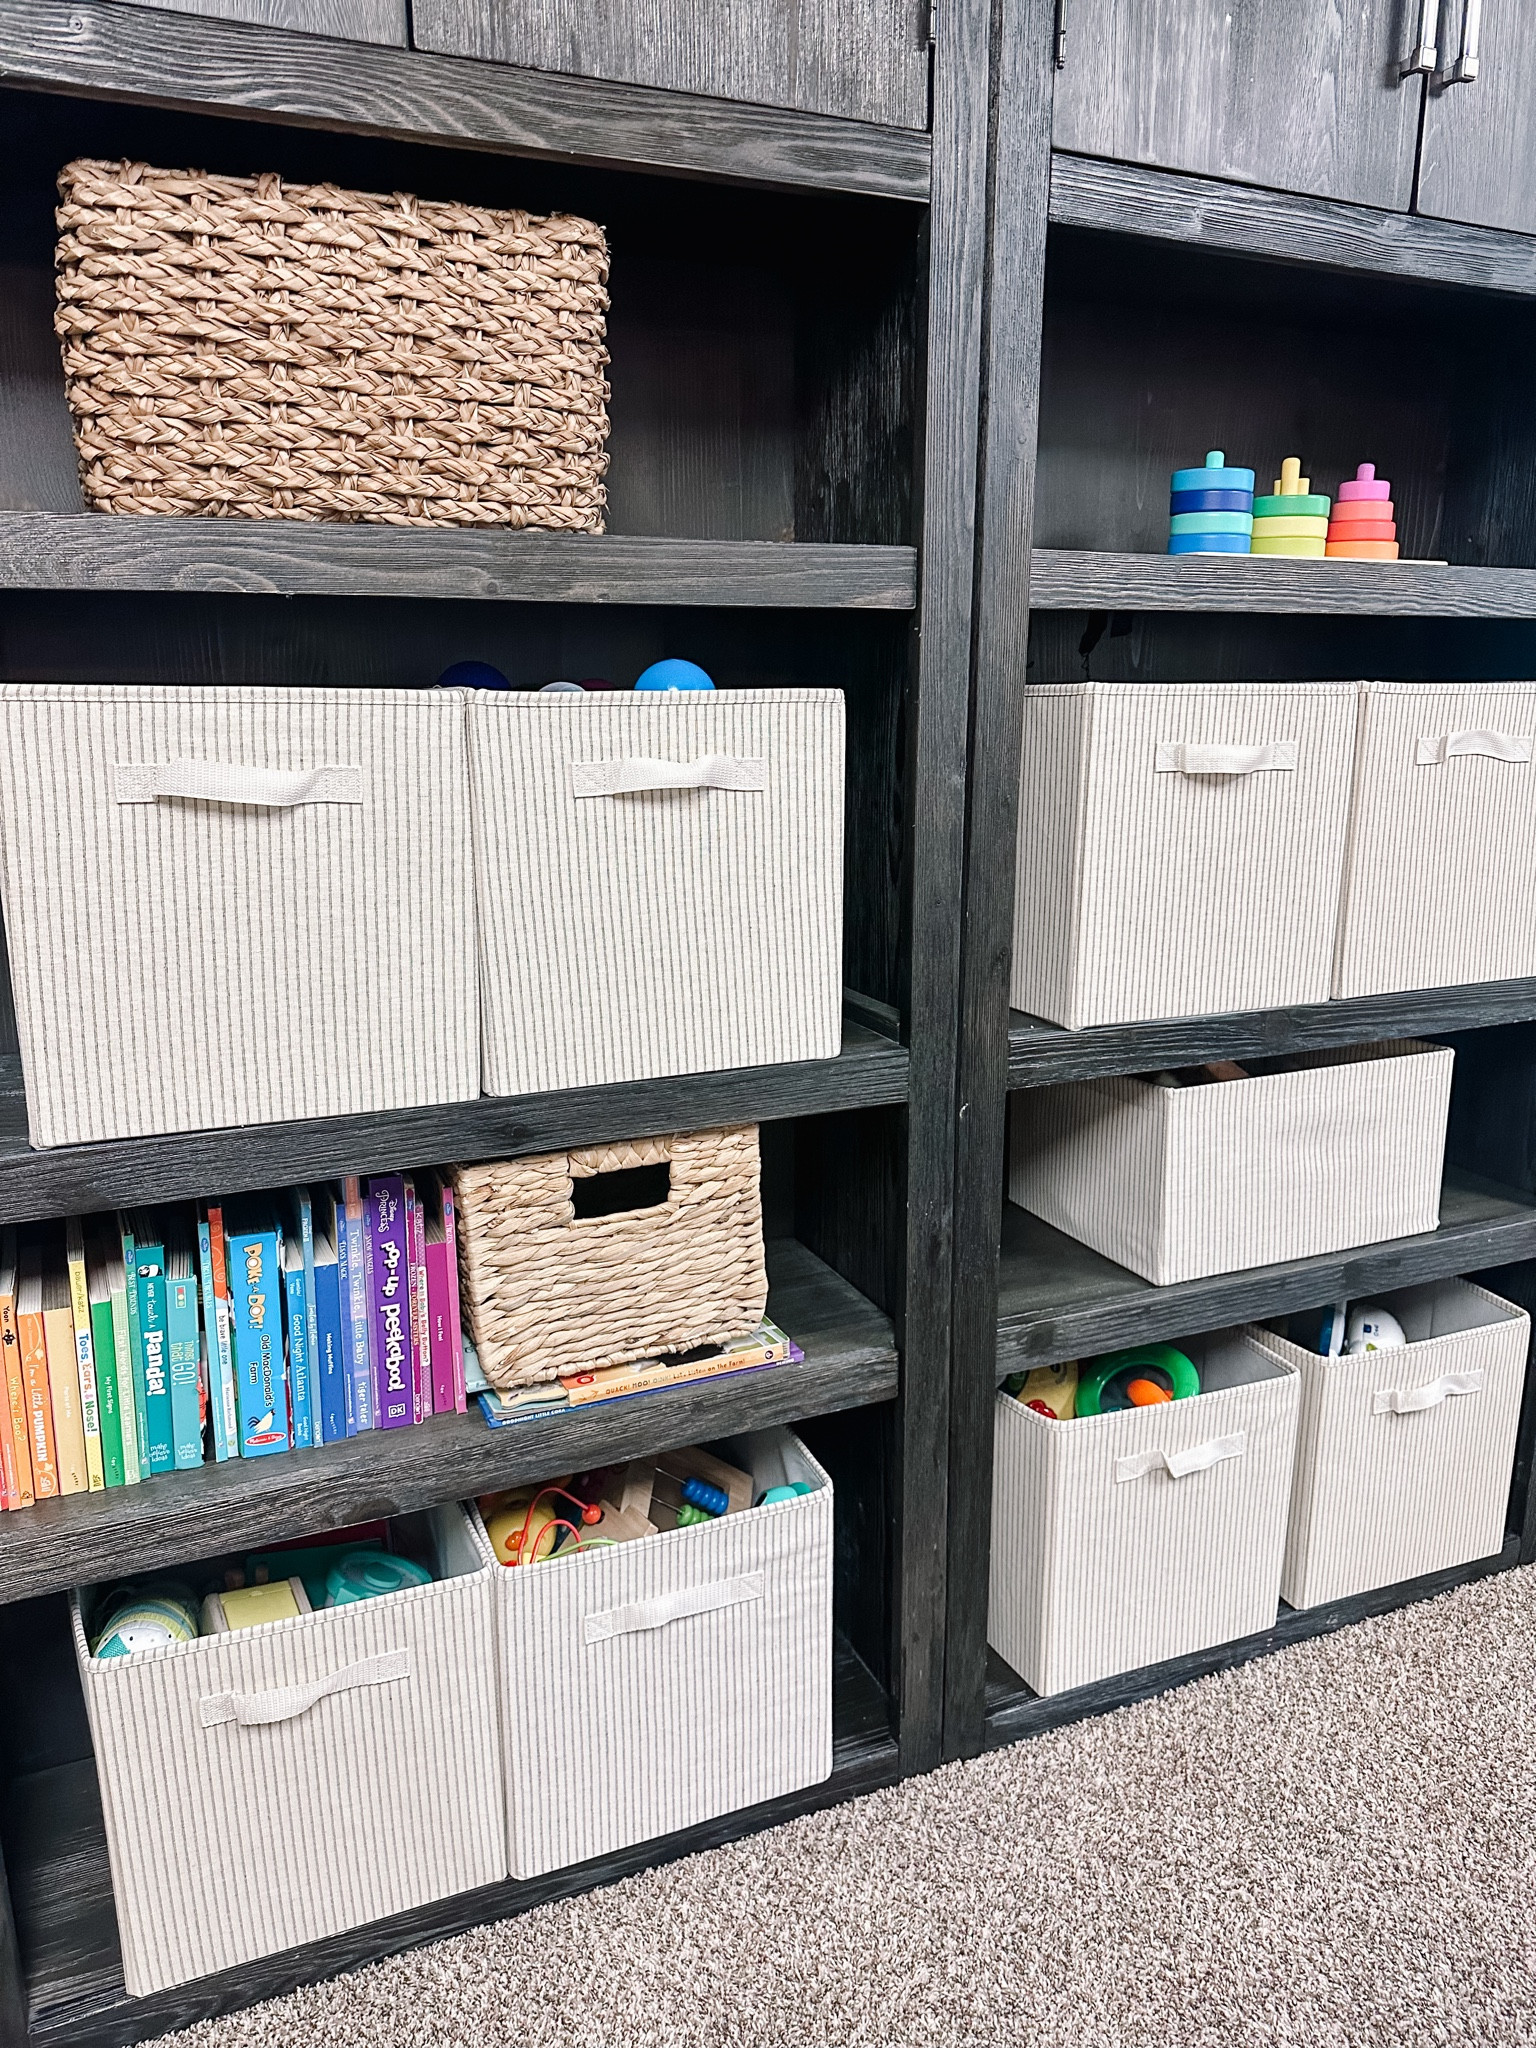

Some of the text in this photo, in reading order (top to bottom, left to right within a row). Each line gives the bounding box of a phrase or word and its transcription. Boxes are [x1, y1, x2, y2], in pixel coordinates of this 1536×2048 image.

[375, 1189, 390, 1233] PRINCESS
[388, 1198, 398, 1222] Disney
[350, 1229, 365, 1365] Twinkle, Twinkle, Little Baby
[380, 1240, 406, 1393] pop-up peekaboo!
[171, 1362, 196, 1386] GO!
[249, 1361, 259, 1385] Farm
[260, 1334, 275, 1408] Old MacDonald's
[292, 1314, 306, 1401] Good Night Atlanta
[79, 1333, 89, 1363] Toes,
[84, 1400, 98, 1432] Nose!
[356, 1381, 369, 1424] tiger tales
[605, 1384, 630, 1395] QUACK!
[632, 1380, 651, 1389] MOO!
[10, 1376, 26, 1442] Where's Boo?
[388, 1404, 405, 1416] DK
[33, 1410, 48, 1462] PUMPKIN
